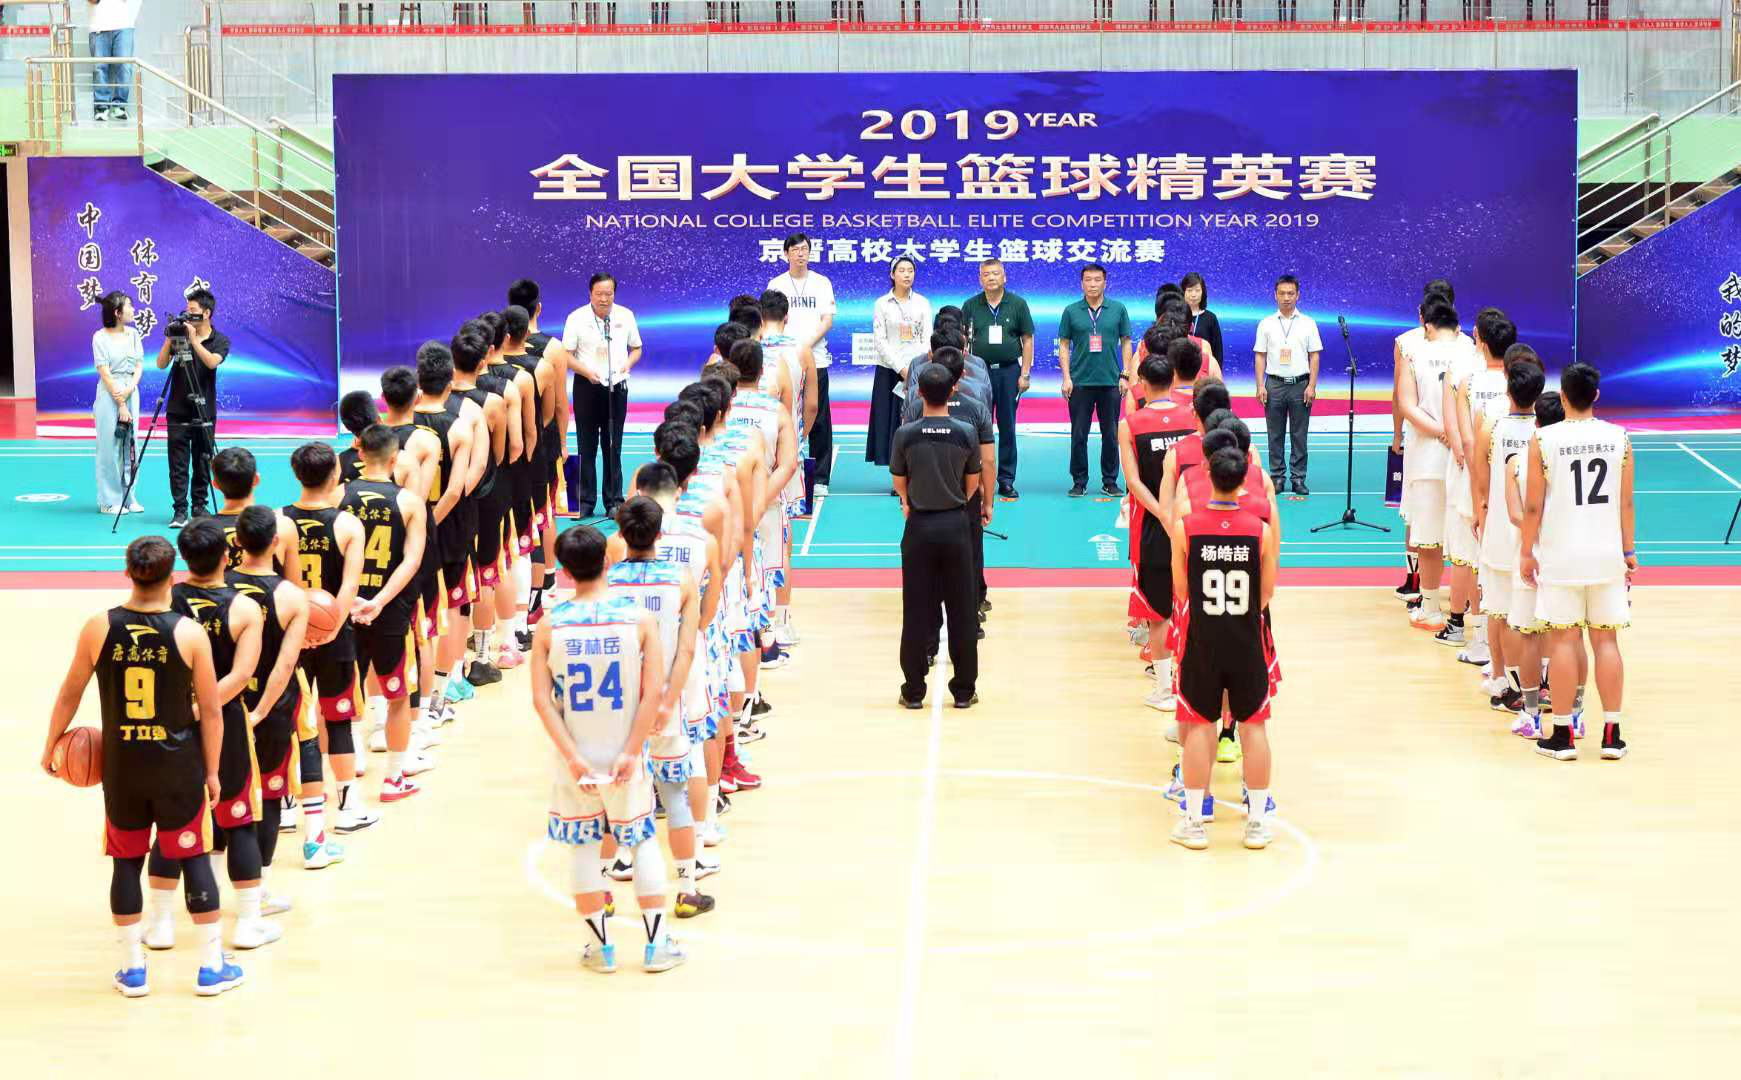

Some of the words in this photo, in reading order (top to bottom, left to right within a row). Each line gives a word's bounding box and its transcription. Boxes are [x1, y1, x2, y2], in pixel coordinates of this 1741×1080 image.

[860, 109, 1019, 141] 2019
[1024, 112, 1098, 128] YEAR
[530, 153, 1377, 200] 全国大学生篮球精英赛
[586, 214, 706, 229] NATIONAL
[713, 214, 813, 228] COLLEGE
[822, 214, 960, 228] BASKETBALL
[968, 214, 1023, 228] ELITE
[1031, 213, 1192, 228] COMPETITION
[1199, 213, 1260, 228] YEAR
[1265, 213, 1320, 228] 2019
[77, 202, 103, 310] 中国梦
[131, 238, 158, 338] 体育梦
[790, 296, 816, 308] HINA
[1570, 458, 1609, 506] 12
[365, 525, 392, 568] 4
[1201, 545, 1250, 562] 杨皓喆
[1202, 569, 1250, 616] 99
[565, 637, 620, 656] 李林岳
[125, 667, 155, 719] 9
[567, 661, 623, 711] 24
